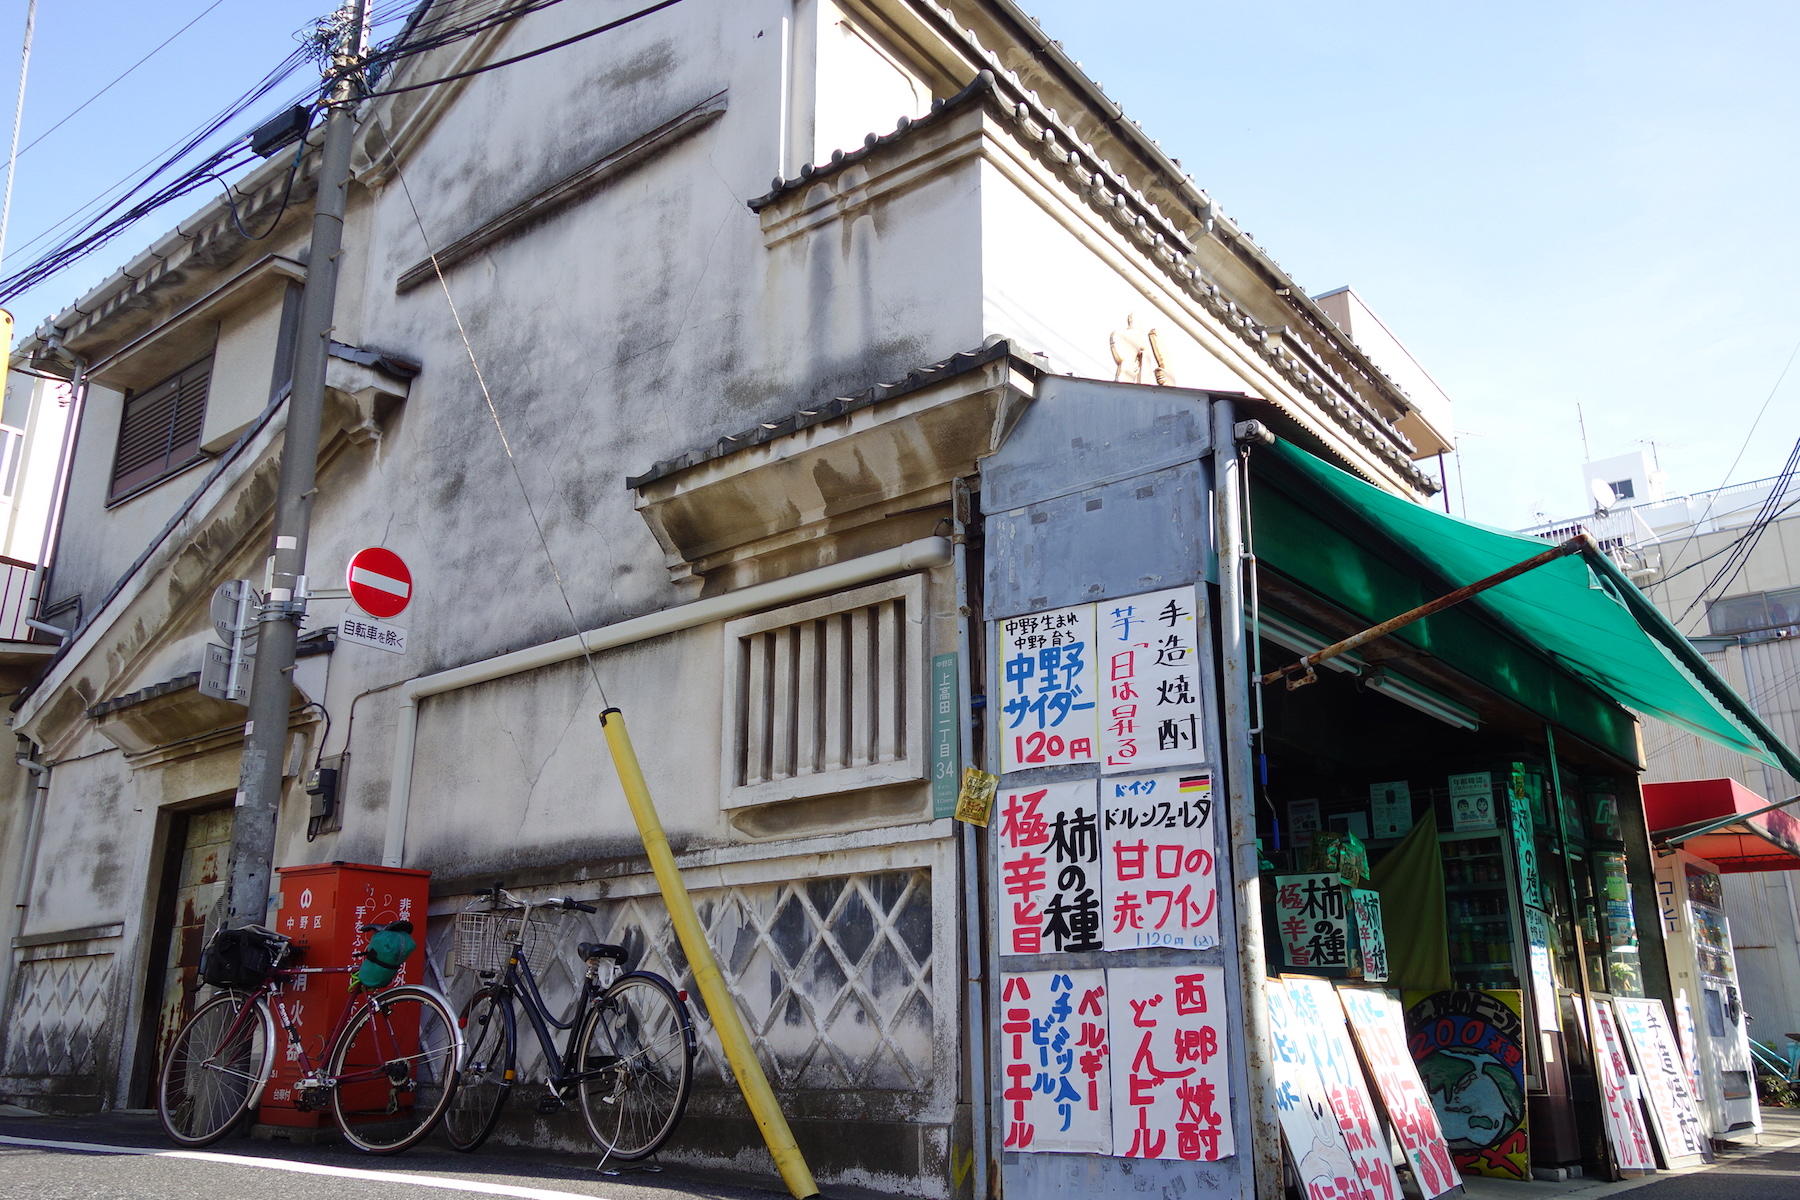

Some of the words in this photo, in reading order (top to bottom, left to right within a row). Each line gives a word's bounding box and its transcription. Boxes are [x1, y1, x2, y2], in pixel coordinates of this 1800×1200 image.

[1005, 613, 1079, 636] 中野生まれ
[1013, 631, 1076, 650] 中野育ち
[1343, 620, 1404, 648] 自転車を除く
[1006, 642, 1084, 694] 中野
[1153, 599, 1200, 751] 手造焼酎
[938, 673, 951, 758] 上高田一丁目
[1003, 685, 1096, 729] サイダー
[936, 761, 954, 780] 34
[1015, 731, 1092, 764] 120円
[1115, 780, 1157, 798] ドイツ
[1000, 789, 1050, 953] 極辛旨
[1041, 807, 1103, 952] 柿の種
[1112, 839, 1214, 881] 甘口の
[286, 915, 322, 930] 中野区
[1112, 884, 1216, 934] 赤ワイン
[1136, 931, 1184, 946] 1120円
[1277, 883, 1311, 966] 極辛旨
[1297, 877, 1347, 966] 柿の種
[1362, 892, 1388, 979] 柿の種
[1002, 977, 1034, 1148] ハニーエール
[1032, 1013, 1056, 1094] ビール
[1050, 974, 1081, 1132] ハチミツ入り
[1075, 985, 1109, 1111] ベルギー
[1125, 993, 1196, 1158] どんビール
[1175, 973, 1222, 1161] 西郷焼酎
[1391, 1104, 1428, 1152] ビール
